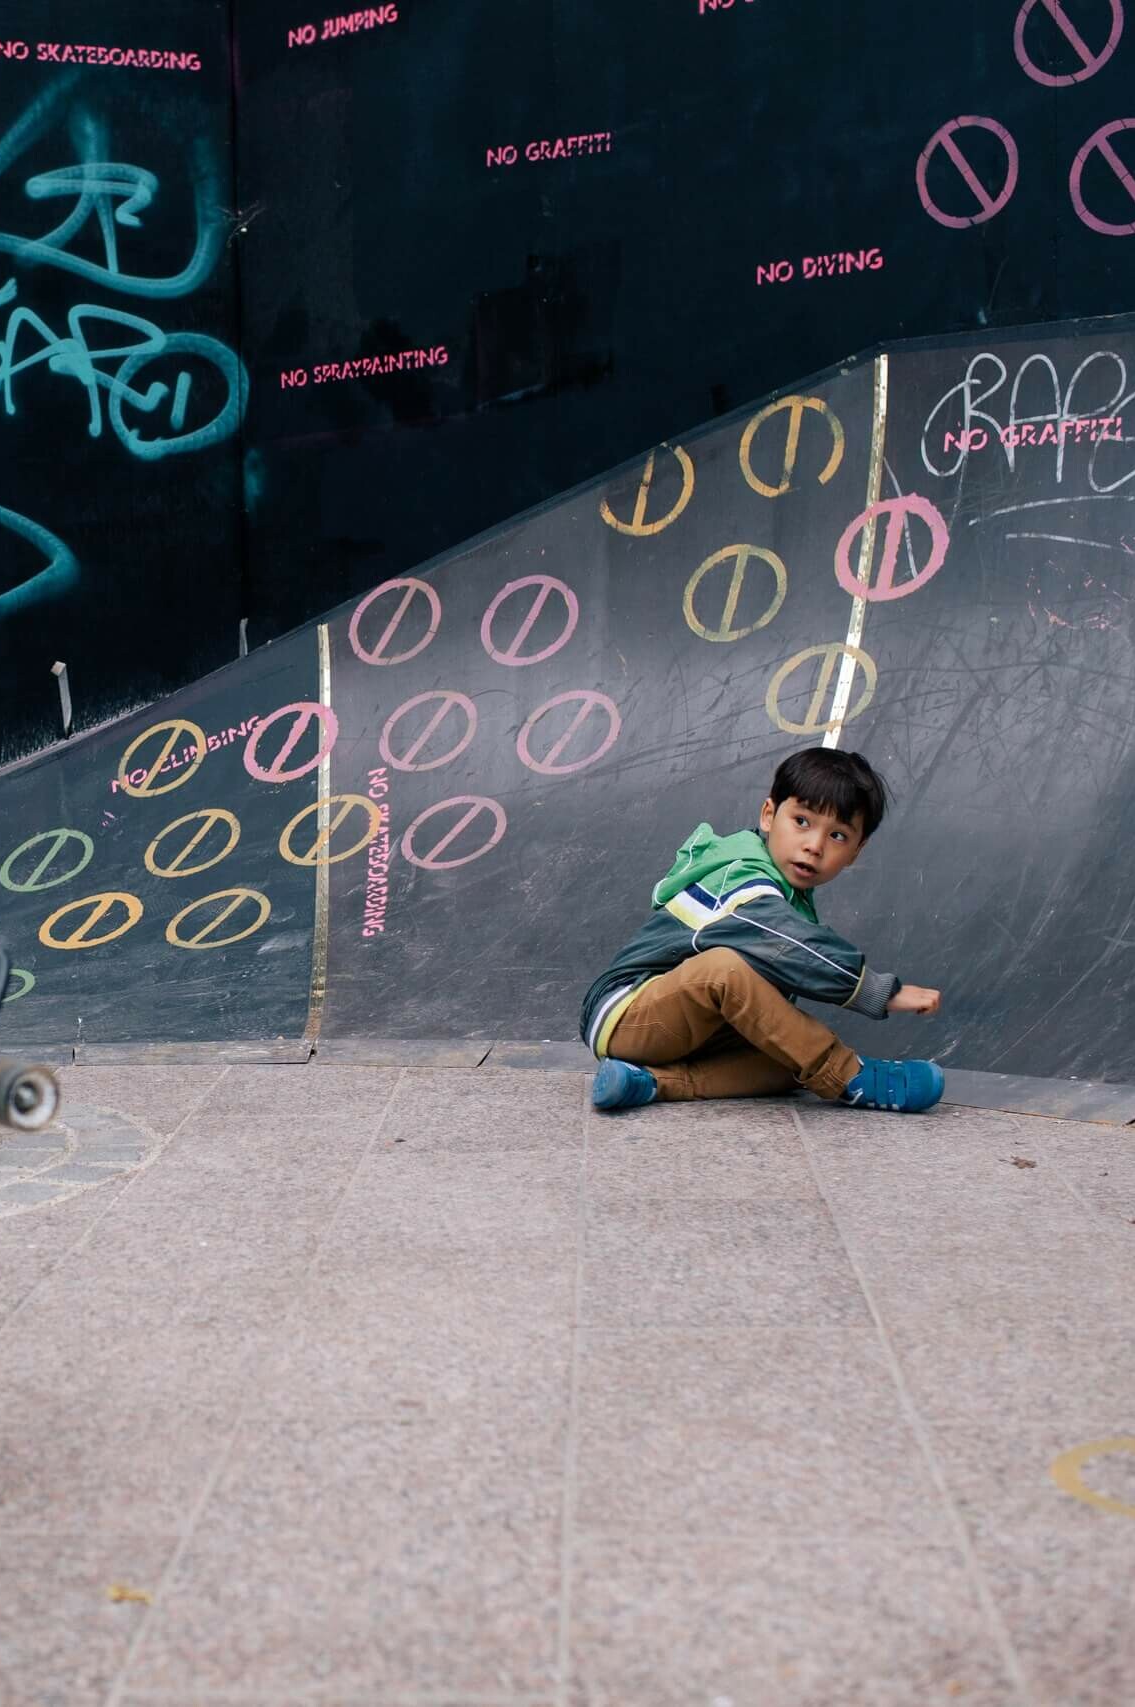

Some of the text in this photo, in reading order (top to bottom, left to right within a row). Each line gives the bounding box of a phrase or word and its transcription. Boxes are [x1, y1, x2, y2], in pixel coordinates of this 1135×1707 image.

[288, 3, 398, 48] NO JUMPING
[36, 43, 202, 71] SKATEBOARDING
[486, 132, 611, 167] NO GRAFFITI
[756, 248, 883, 285] NO DIVING
[281, 346, 449, 389] NO SPRAYPAINTING
[944, 417, 1123, 452] NO GRAFFITI
[368, 767, 389, 799] NO
